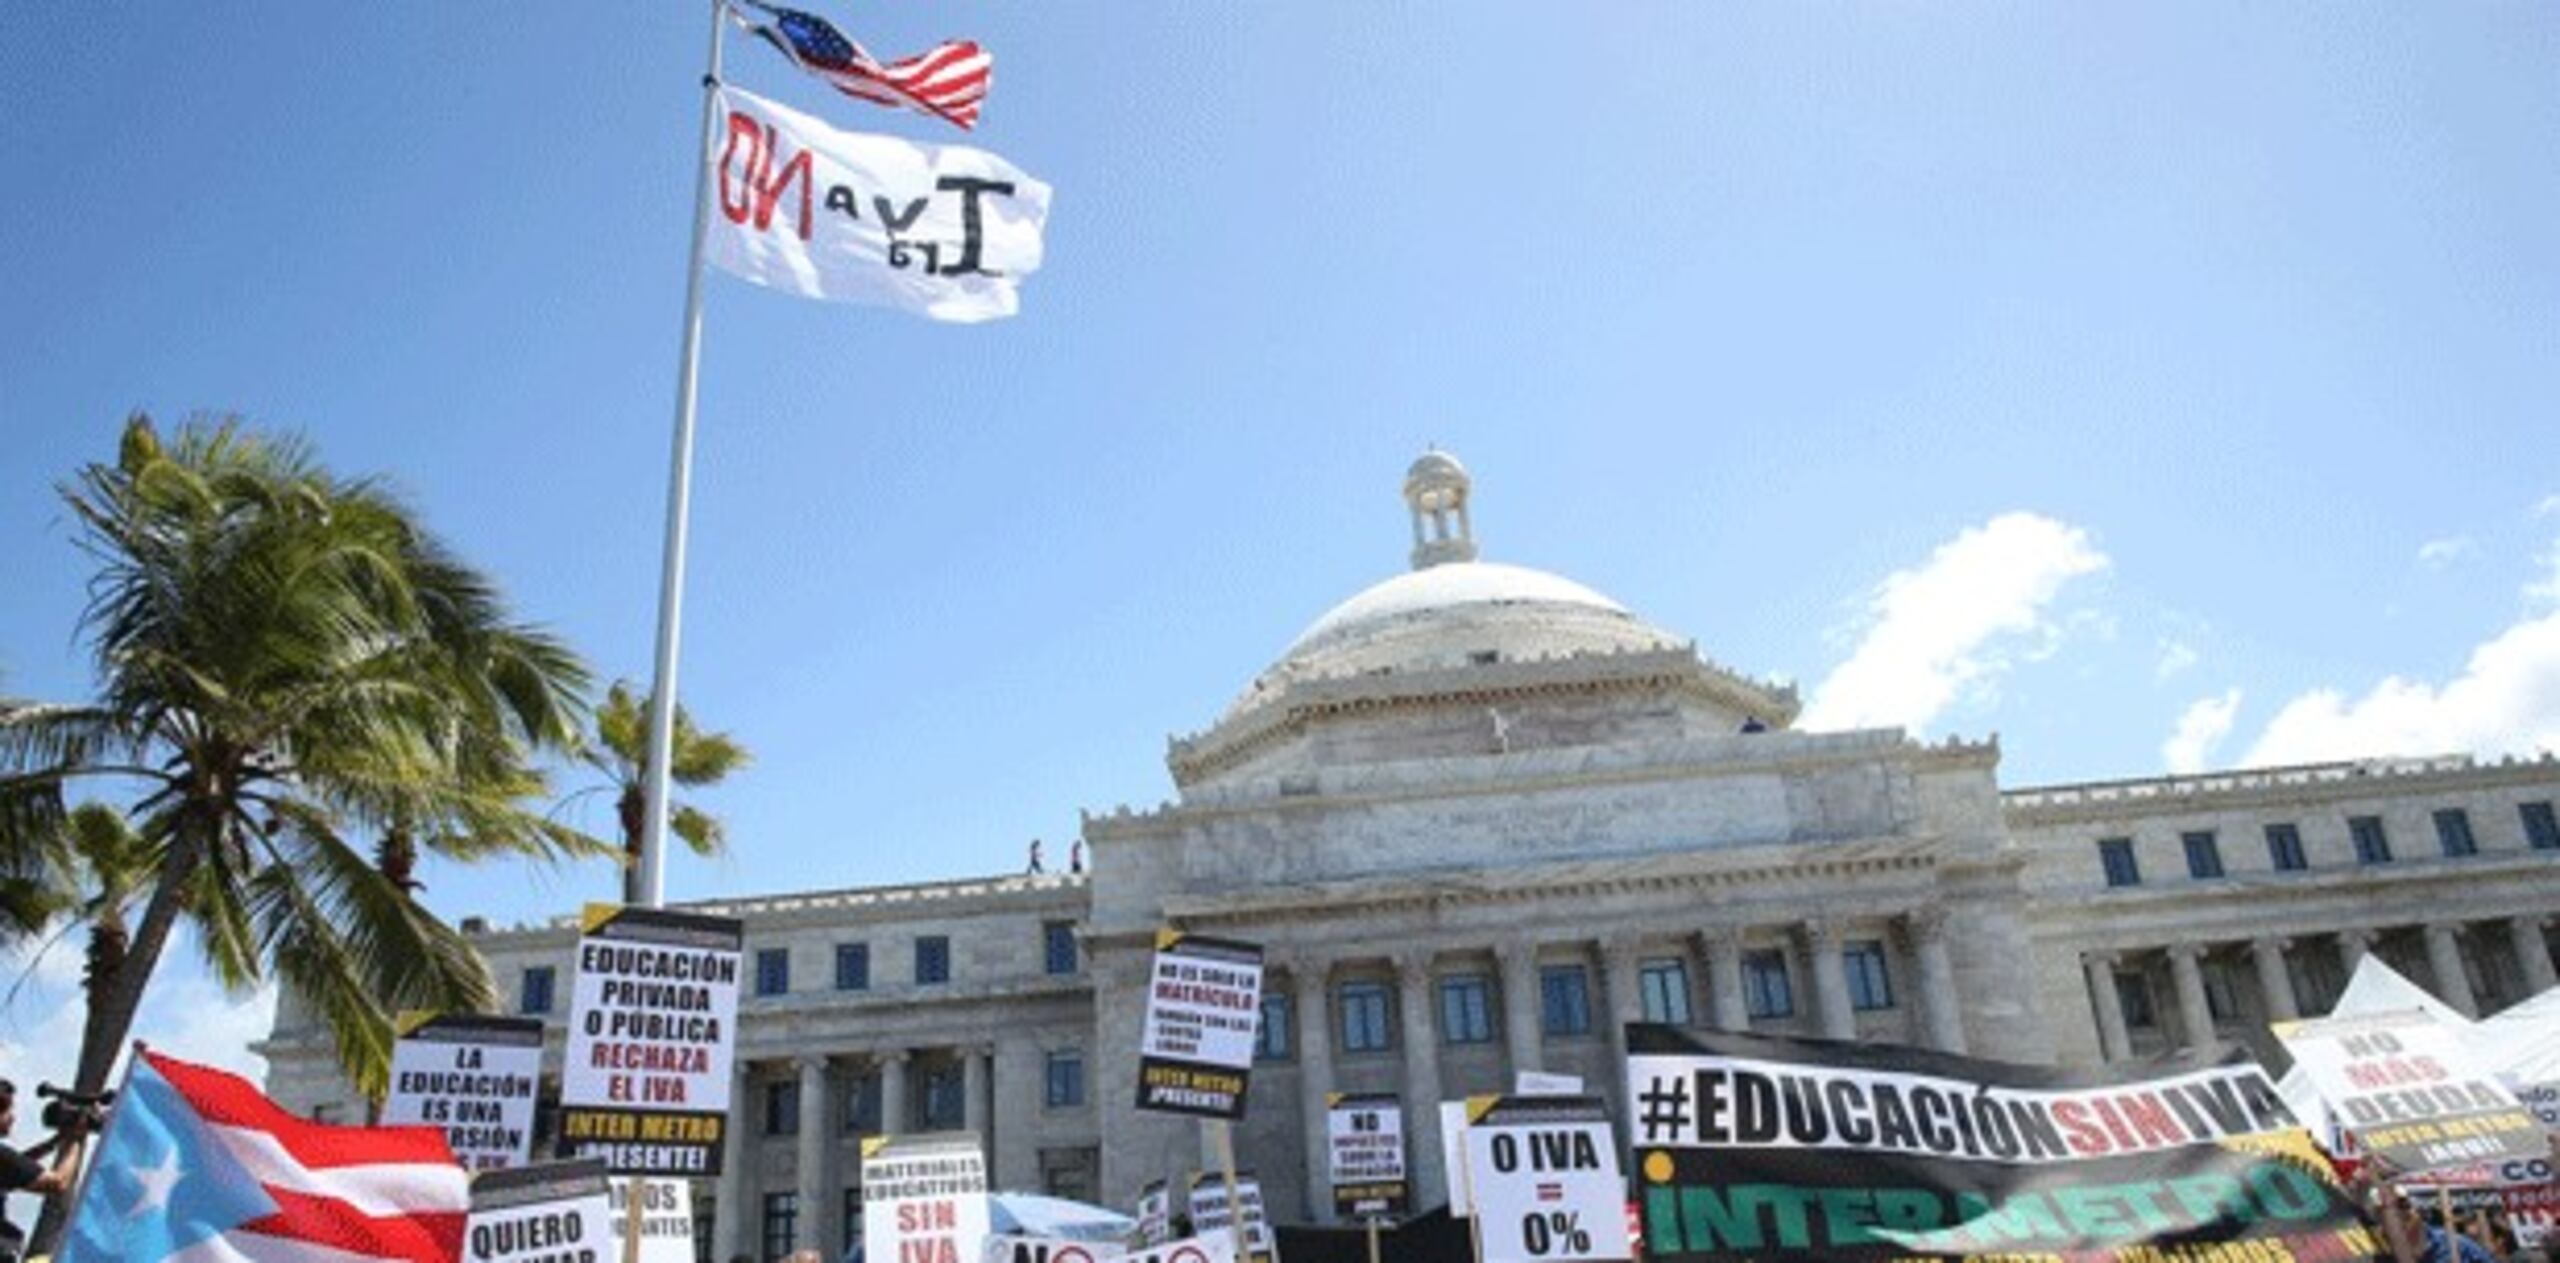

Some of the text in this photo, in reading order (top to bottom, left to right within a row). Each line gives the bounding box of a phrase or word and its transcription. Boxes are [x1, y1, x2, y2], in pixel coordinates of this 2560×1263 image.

[581, 944, 735, 985] EDUCACIÓN
[601, 980, 711, 1012] PRIVADA
[584, 1009, 720, 1044] O PÚBLICA
[456, 1047, 482, 1069] LA
[591, 1043, 709, 1073] RECHAZA
[2339, 1031, 2404, 1057] NO
[398, 1071, 531, 1098] EDUCACIÓN
[609, 1074, 686, 1103] EL IVA
[422, 1099, 502, 1123] ES UNA
[2344, 1081, 2507, 1123] DEUDA
[566, 1112, 721, 1143] INTER METRO
[1528, 1130, 1600, 1172] IVA
[897, 1200, 956, 1234] SIN
[472, 1210, 582, 1260] QUIERO
[899, 1238, 960, 1263] IVA
[1523, 1210, 1592, 1260] 0%
